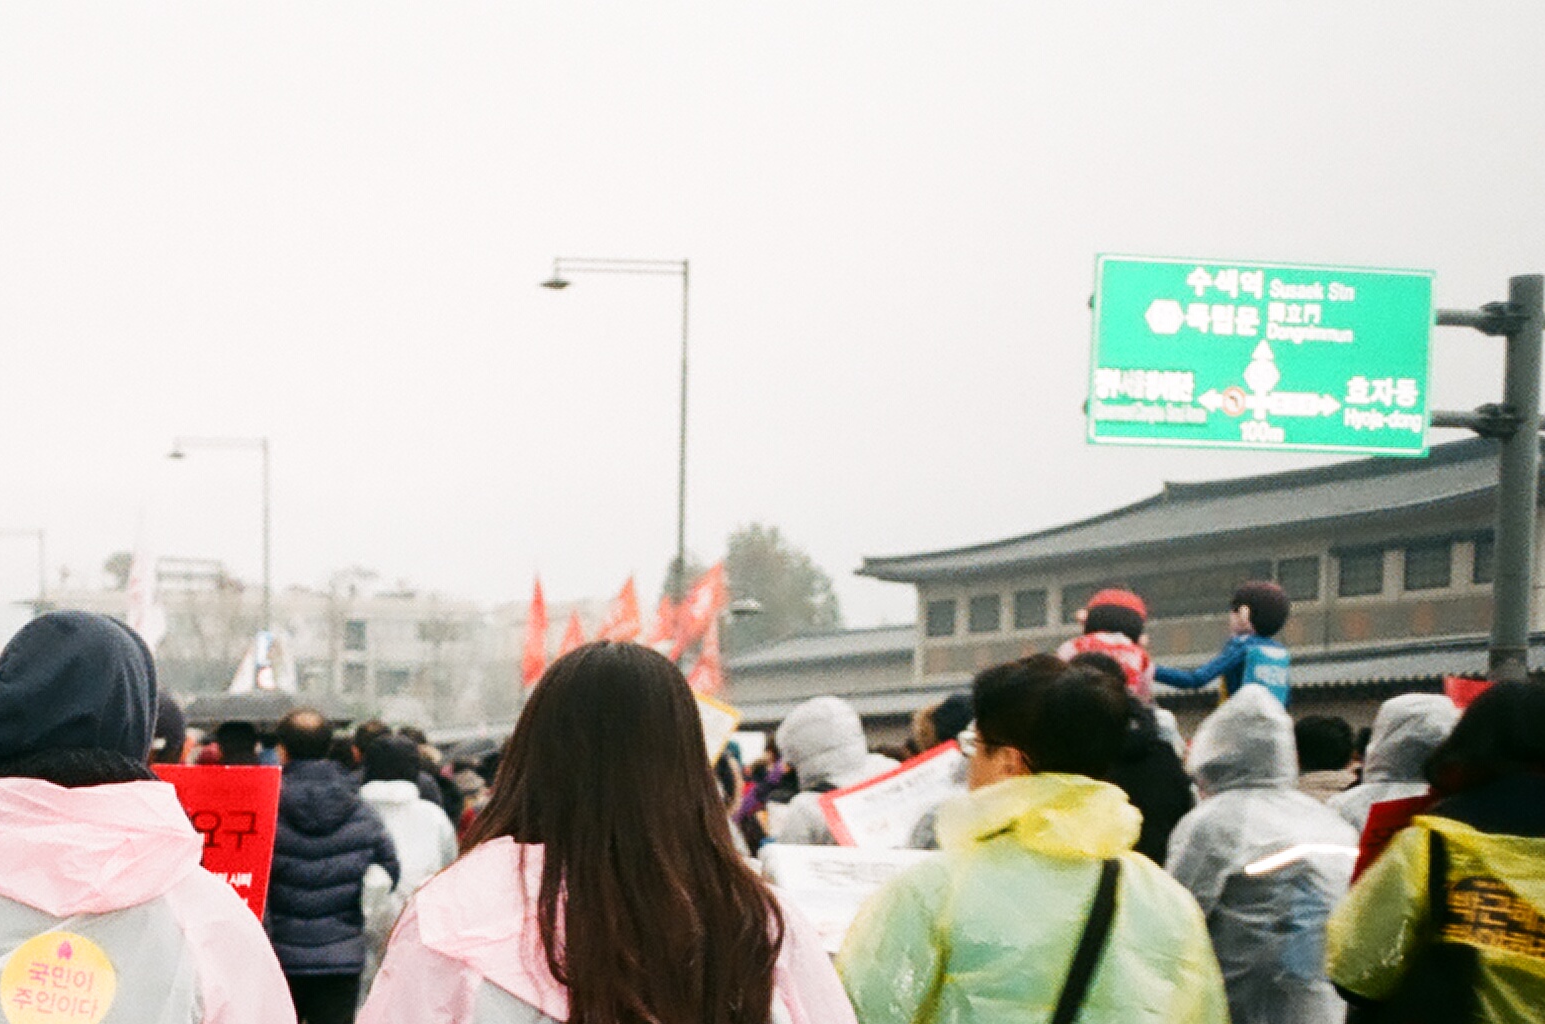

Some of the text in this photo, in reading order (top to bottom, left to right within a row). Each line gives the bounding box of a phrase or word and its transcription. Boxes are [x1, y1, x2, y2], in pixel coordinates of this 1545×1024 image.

[1186, 267, 1263, 299] 수색역
[1186, 303, 1260, 335] 독립문
[1344, 375, 1419, 408] 효자동
[28, 961, 95, 992] 국민이
[12, 987, 99, 1019] 주인이다
